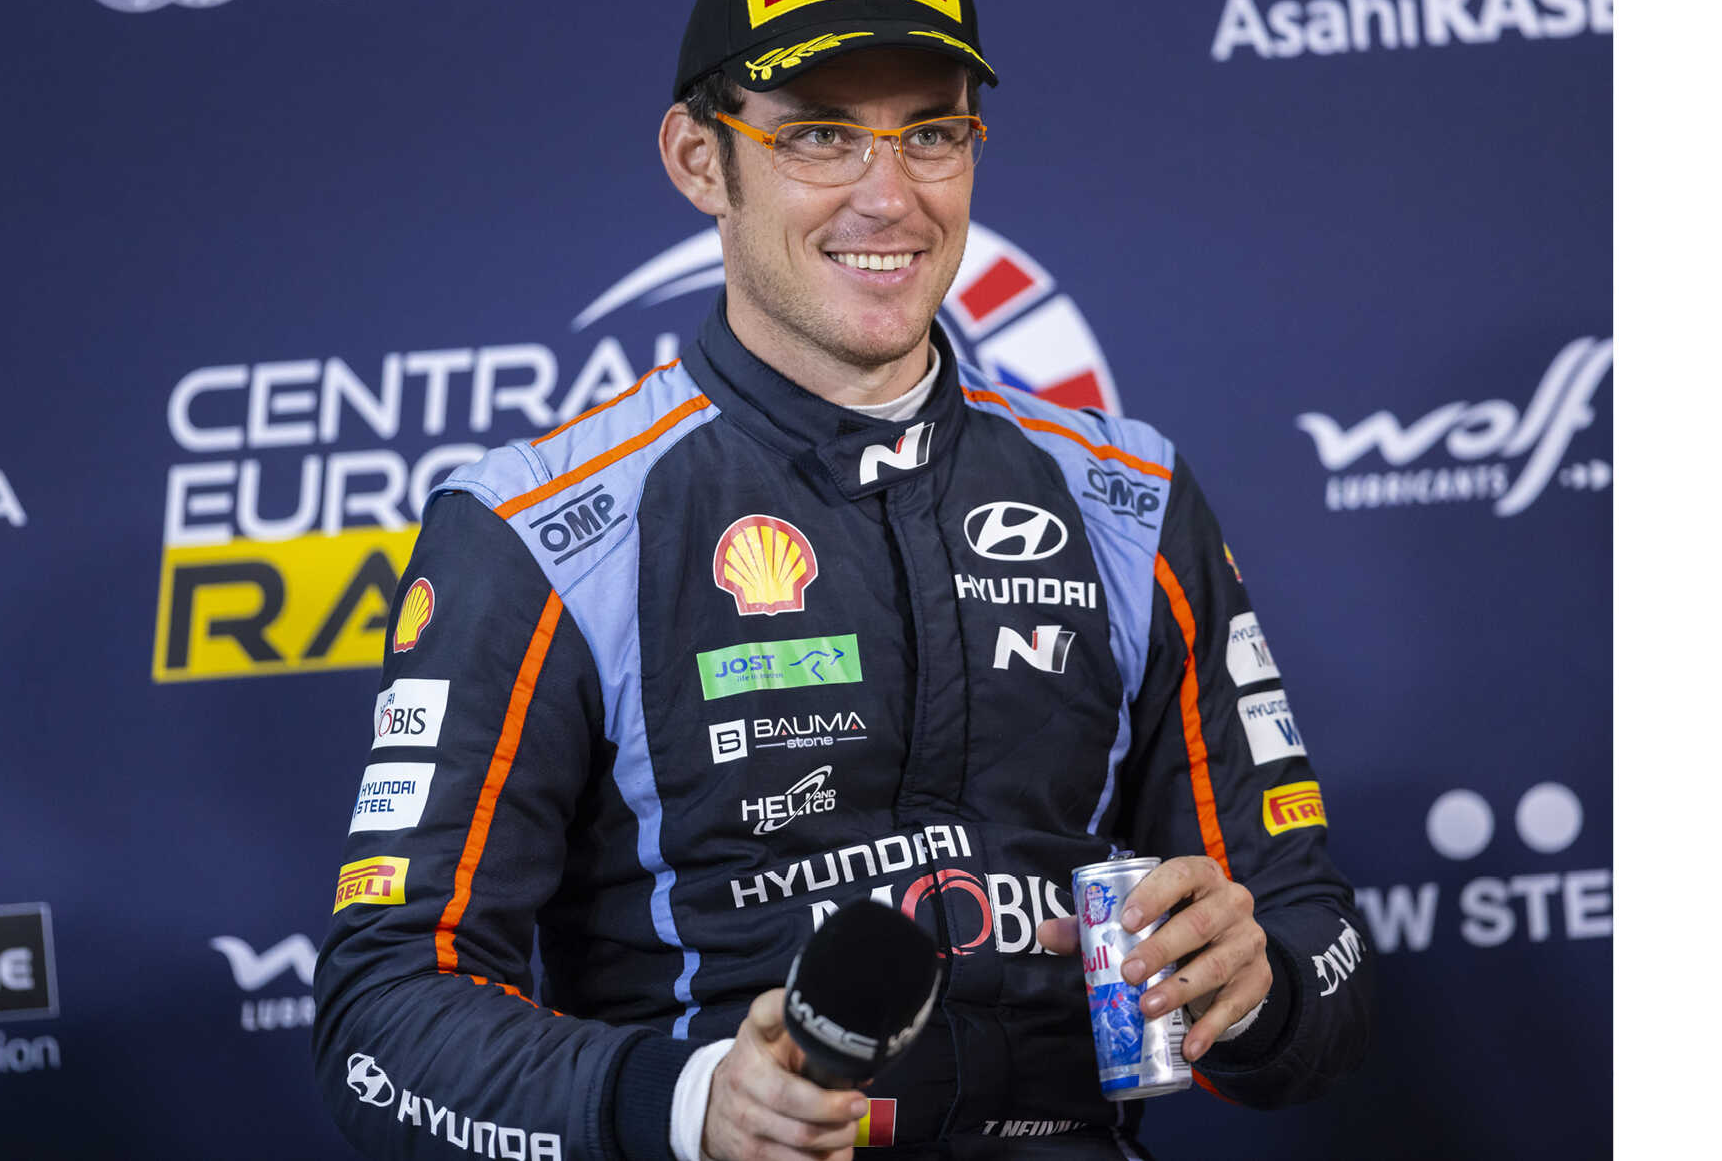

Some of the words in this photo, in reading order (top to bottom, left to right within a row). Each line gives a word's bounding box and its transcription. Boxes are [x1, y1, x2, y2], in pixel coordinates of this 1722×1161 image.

[166, 334, 681, 452] CENTRA
[1087, 468, 1160, 518] OMP
[539, 492, 616, 553] OMP
[955, 574, 1097, 609] HYUNDAI
[715, 655, 775, 678] JOST
[378, 707, 427, 738] OBIS
[754, 711, 866, 738] BAUMA
[786, 736, 834, 749] stone
[359, 781, 416, 795] HYUNDAI
[814, 789, 836, 799] AND
[357, 799, 395, 815] STEEL
[730, 824, 972, 909] HYUNDAI
[335, 864, 397, 906] RELLI
[1459, 869, 1613, 948] STE
[397, 1088, 562, 1161] HYUNDA
